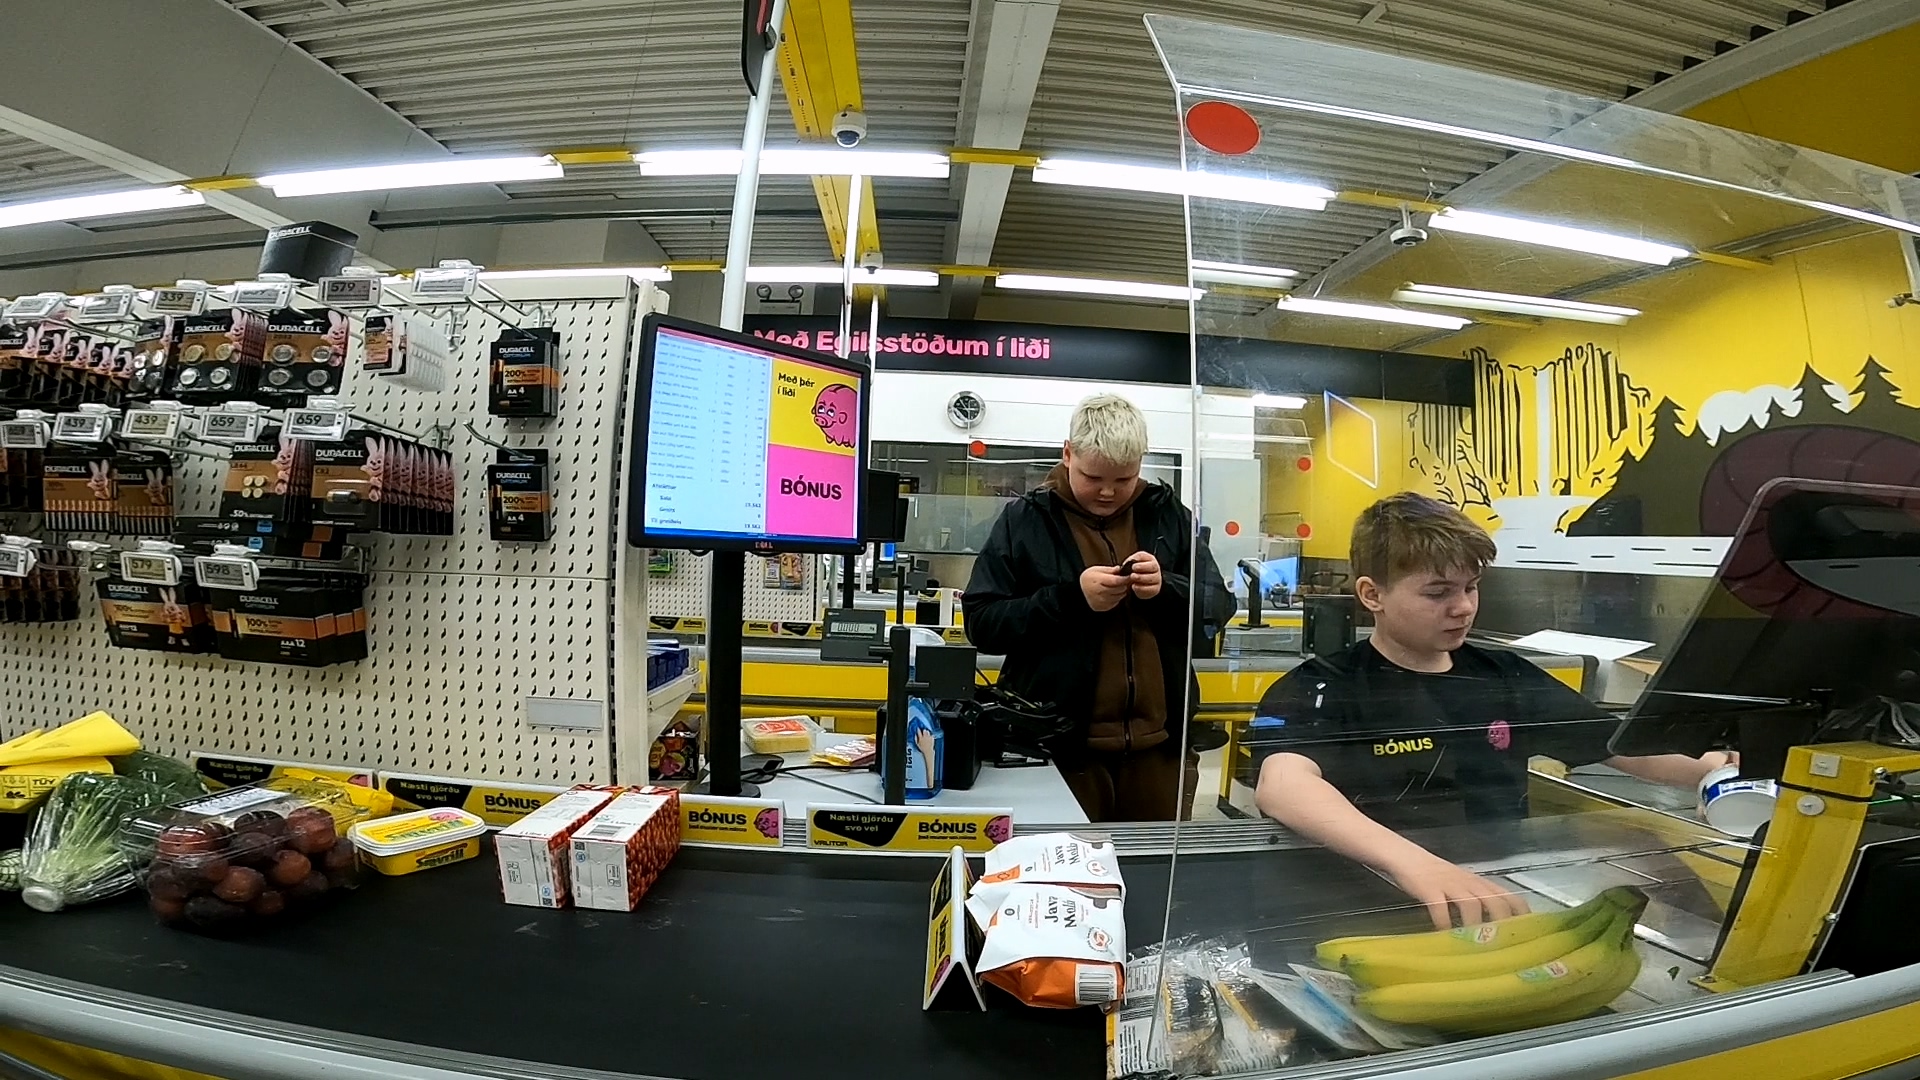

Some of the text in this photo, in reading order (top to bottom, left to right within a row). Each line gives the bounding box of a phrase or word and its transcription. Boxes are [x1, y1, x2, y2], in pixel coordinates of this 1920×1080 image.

[269, 225, 311, 239] DURACELL
[330, 282, 356, 293] 579
[161, 291, 183, 301] 339
[184, 324, 227, 333] DURACELL
[268, 324, 322, 333] DURACELL
[753, 328, 810, 350] Með
[1010, 337, 1051, 360] liði
[499, 346, 535, 354] DURACELL
[505, 369, 525, 378] 200%
[777, 372, 816, 389] Með þér
[518, 386, 525, 394] 4
[777, 385, 796, 398] í liði
[135, 415, 158, 425] 439
[210, 416, 235, 427] 659
[296, 414, 322, 425] 659
[233, 444, 275, 453] DURACELL
[315, 449, 364, 458] DURACELL
[44, 465, 87, 473] DURACELL
[780, 474, 842, 501] BÓNUS
[503, 496, 525, 504] 200%
[518, 513, 525, 522] 4
[131, 560, 152, 569] 579
[206, 563, 230, 575] 598
[107, 584, 149, 594] DURACELL
[239, 595, 279, 605] DURACELL
[295, 639, 306, 648] 12
[1372, 737, 1434, 756] BÓNUS
[400, 781, 460, 794] Næsti gjörðu
[415, 793, 432, 801] svo
[484, 792, 541, 810] BÓNUS
[688, 807, 747, 825] BÓNUS
[829, 813, 894, 824] Næsti gjörðu
[864, 823, 879, 832] vel
[918, 818, 977, 834] BÓNUS
